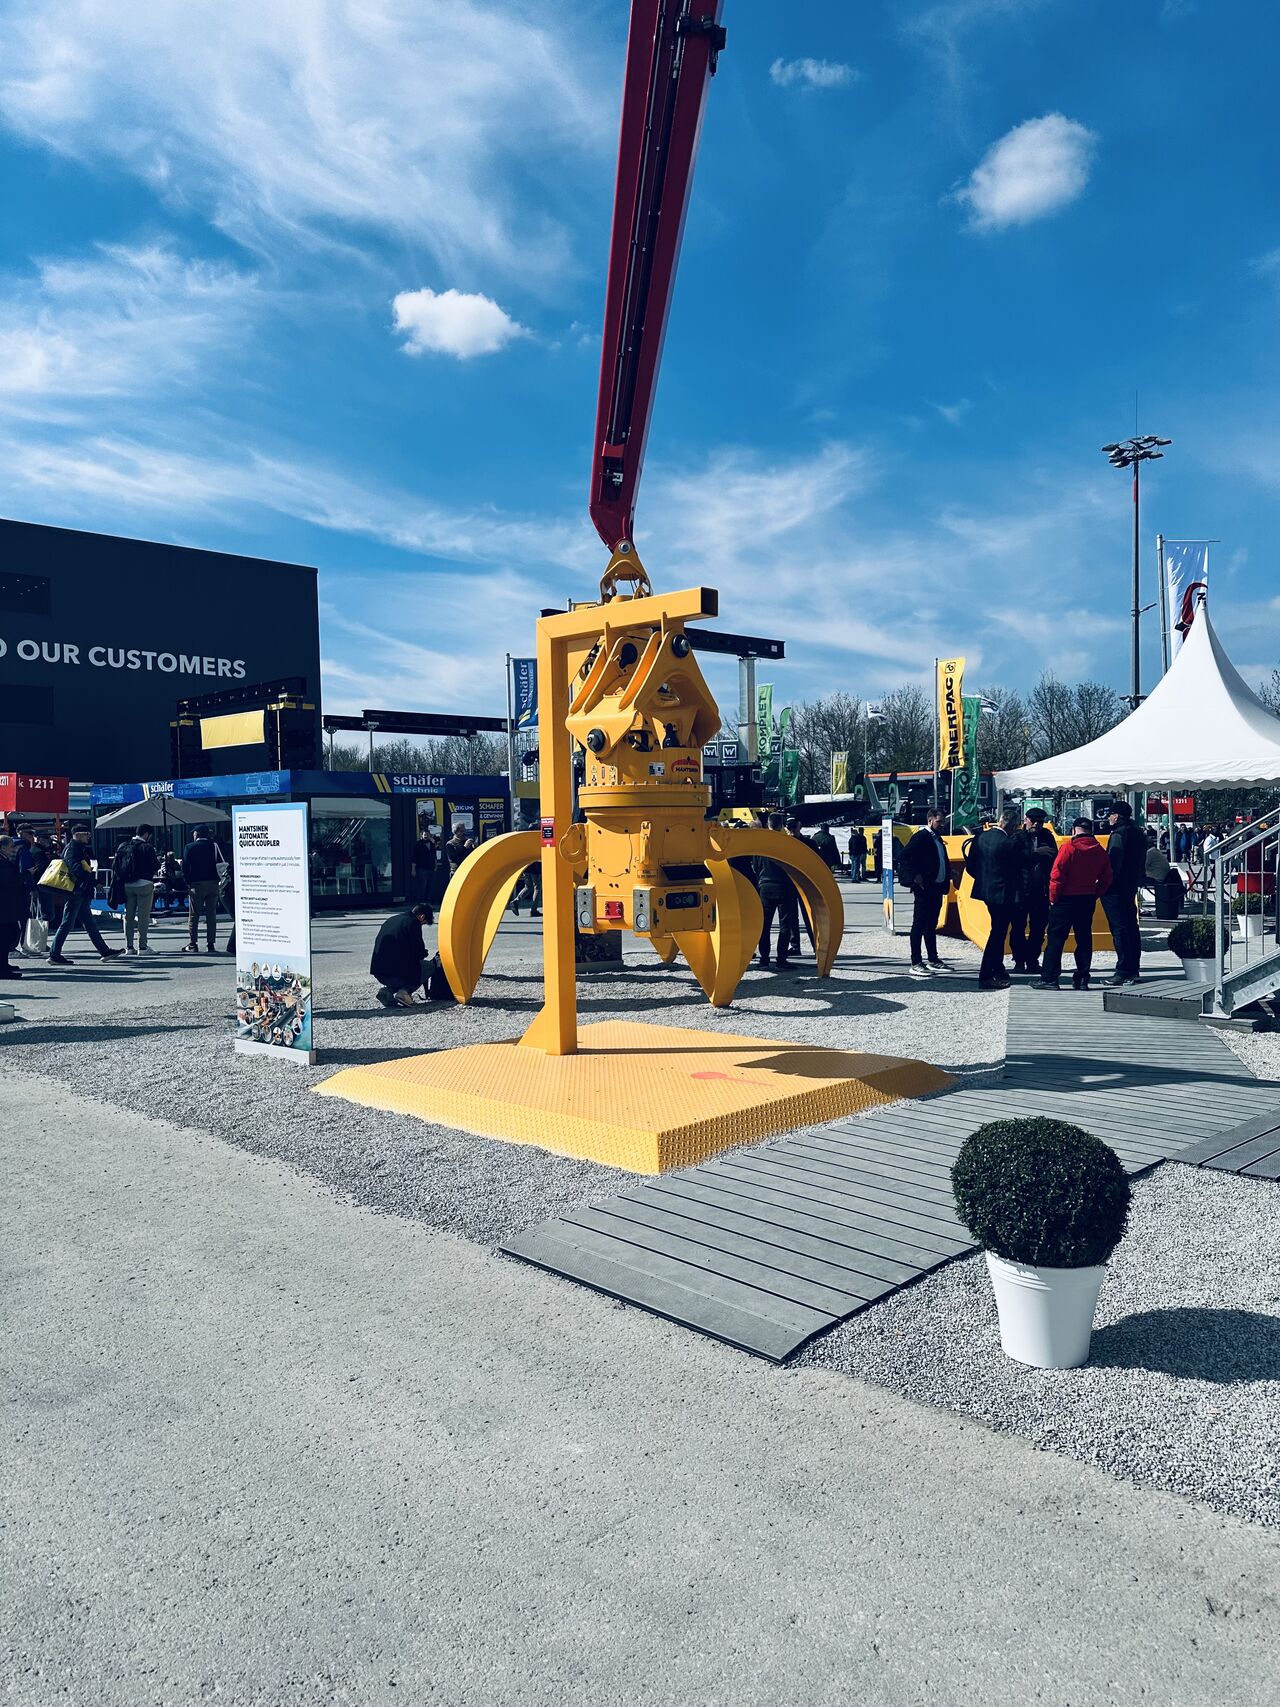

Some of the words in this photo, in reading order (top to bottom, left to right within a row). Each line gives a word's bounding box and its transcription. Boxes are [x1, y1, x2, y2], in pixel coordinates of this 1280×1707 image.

[16, 639, 80, 665] OUR
[88, 646, 246, 679] CUSTOMERS
[759, 695, 767, 755] KOMPLET
[945, 677, 960, 768] ENERPAC
[28, 779, 54, 789] 1211
[393, 775, 446, 786] schäfer
[150, 781, 174, 793] schäfer
[238, 840, 255, 848] QUICK
